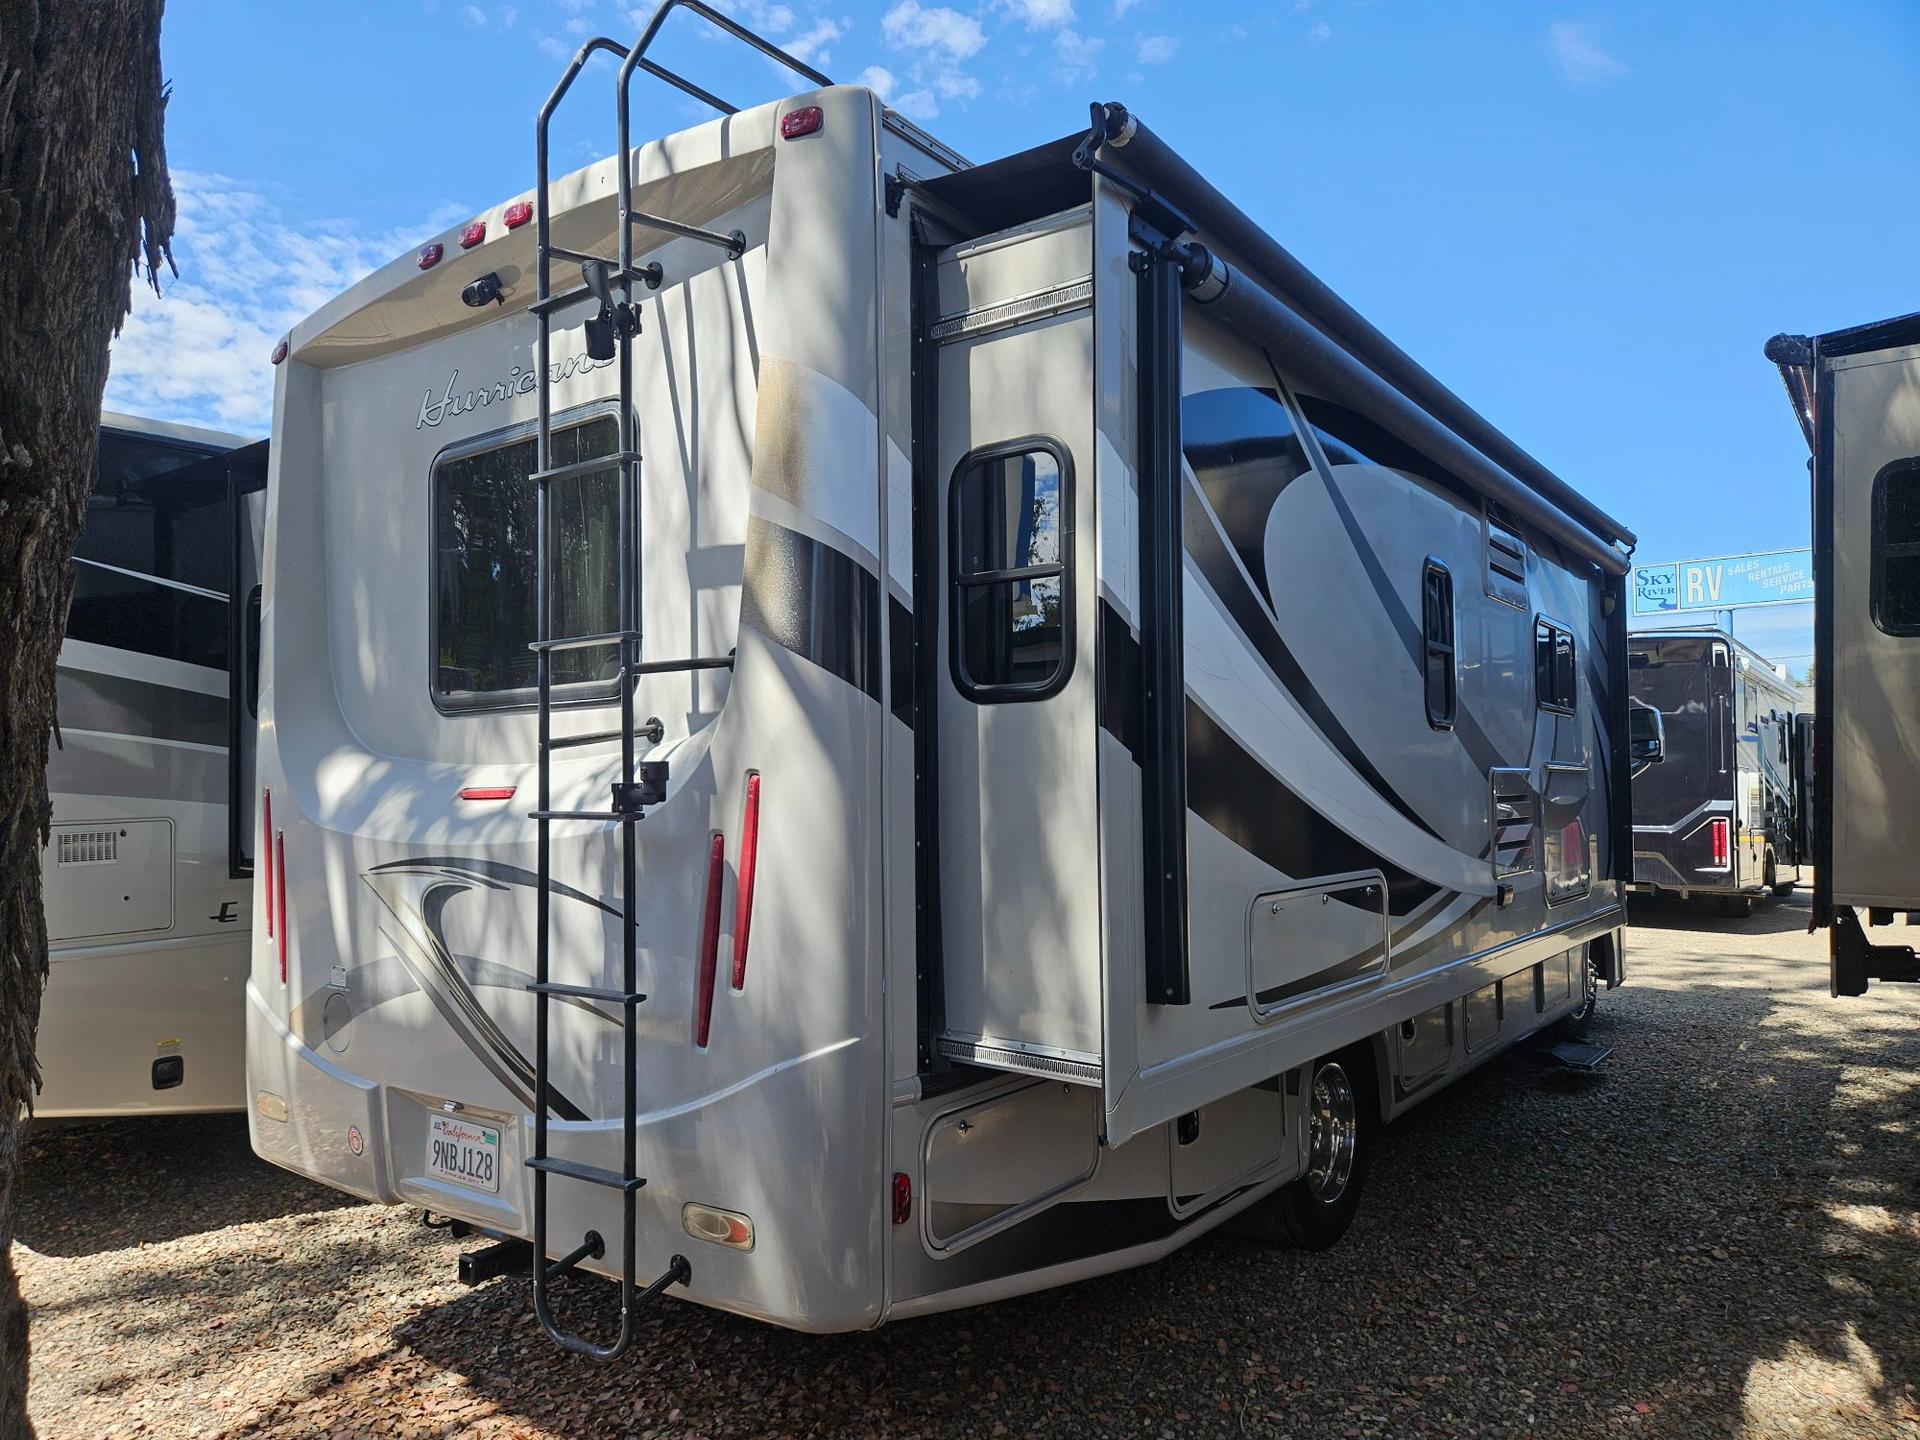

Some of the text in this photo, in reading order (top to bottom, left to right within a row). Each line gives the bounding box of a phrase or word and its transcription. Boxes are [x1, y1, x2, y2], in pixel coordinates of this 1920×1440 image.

[1727, 559, 1760, 576] SALES
[1748, 562, 1791, 583] RENTALS
[1686, 564, 1723, 604] RV
[1762, 570, 1805, 589] SERVICE
[1780, 580, 1814, 595] PARTS
[432, 1140, 493, 1181] 9NBJ128
